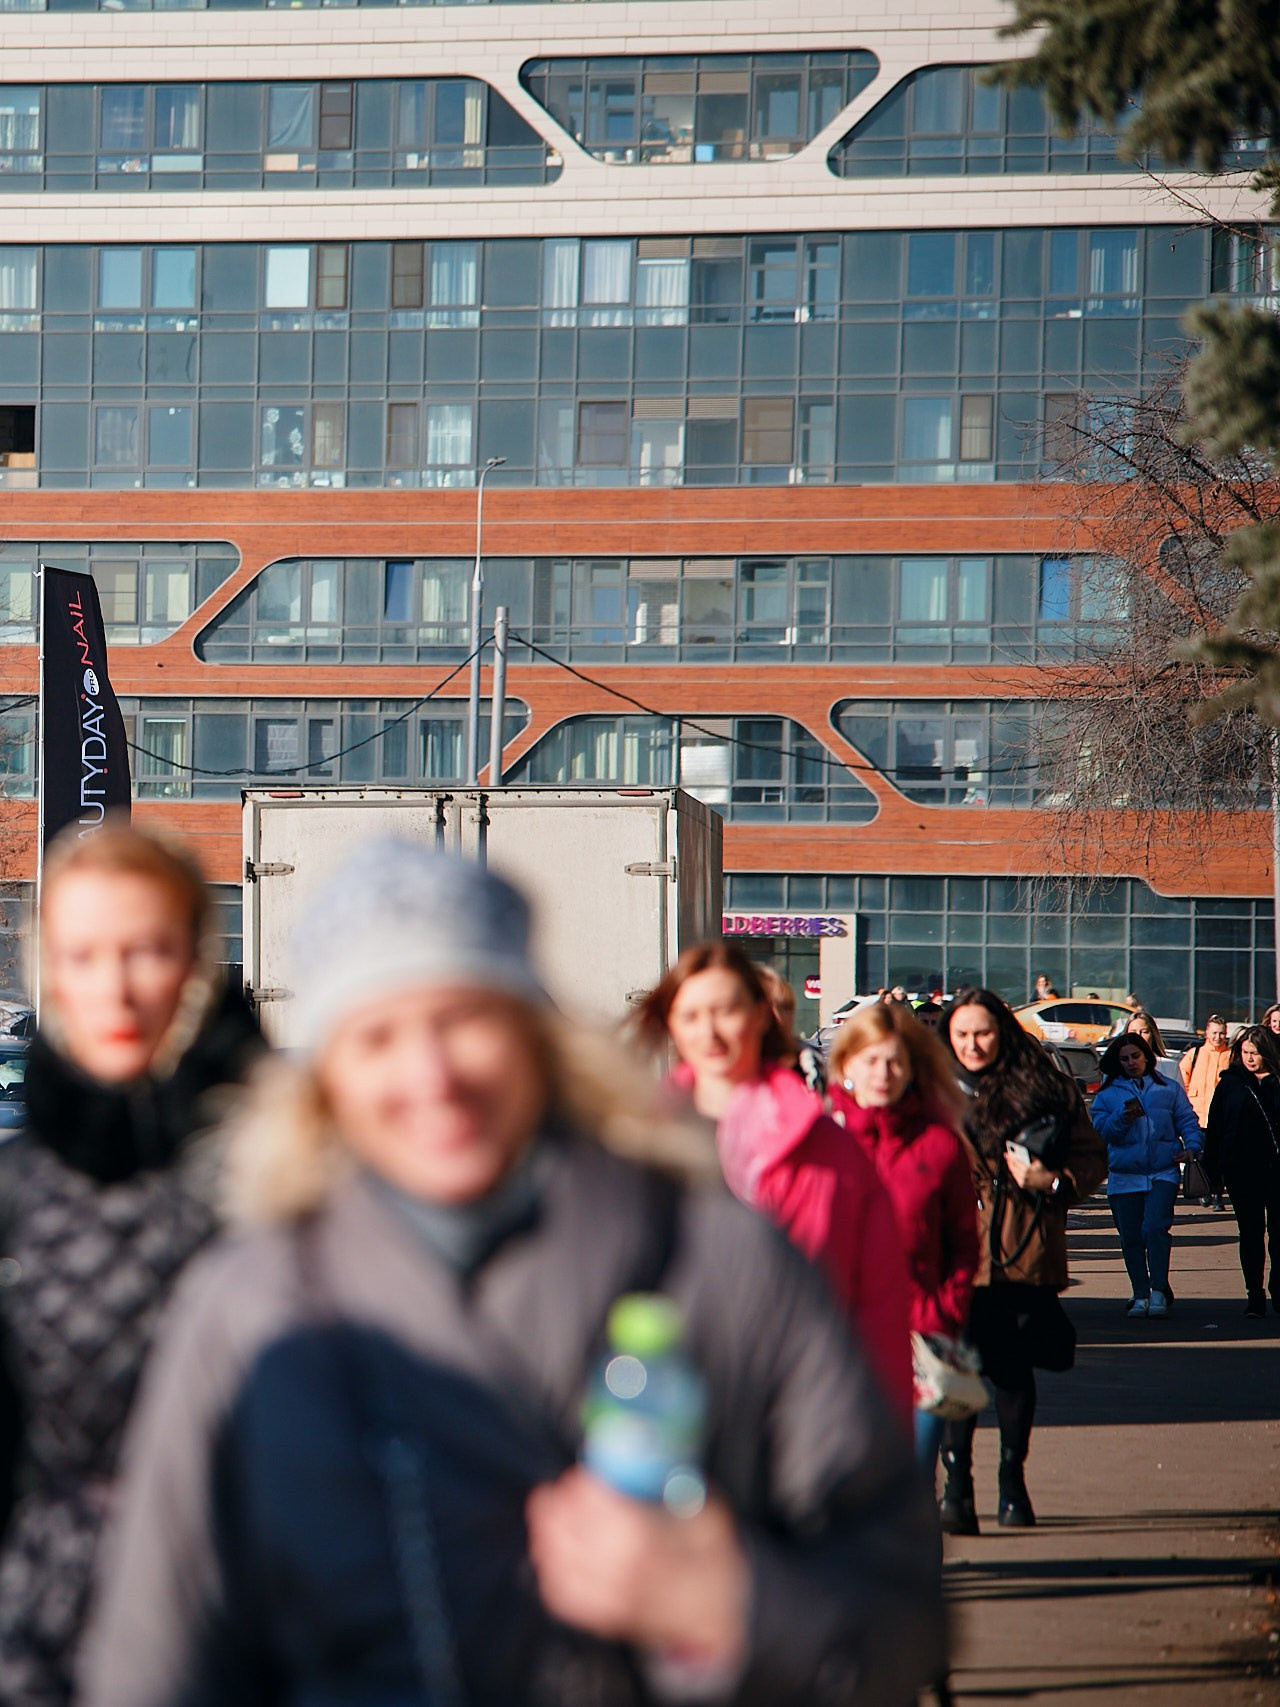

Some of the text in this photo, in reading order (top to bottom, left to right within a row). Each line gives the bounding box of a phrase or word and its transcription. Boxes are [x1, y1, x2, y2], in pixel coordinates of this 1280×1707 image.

[69, 590, 107, 839] AUTYDAY PRO NAIL
[722, 916, 846, 936] LDBERRIES
